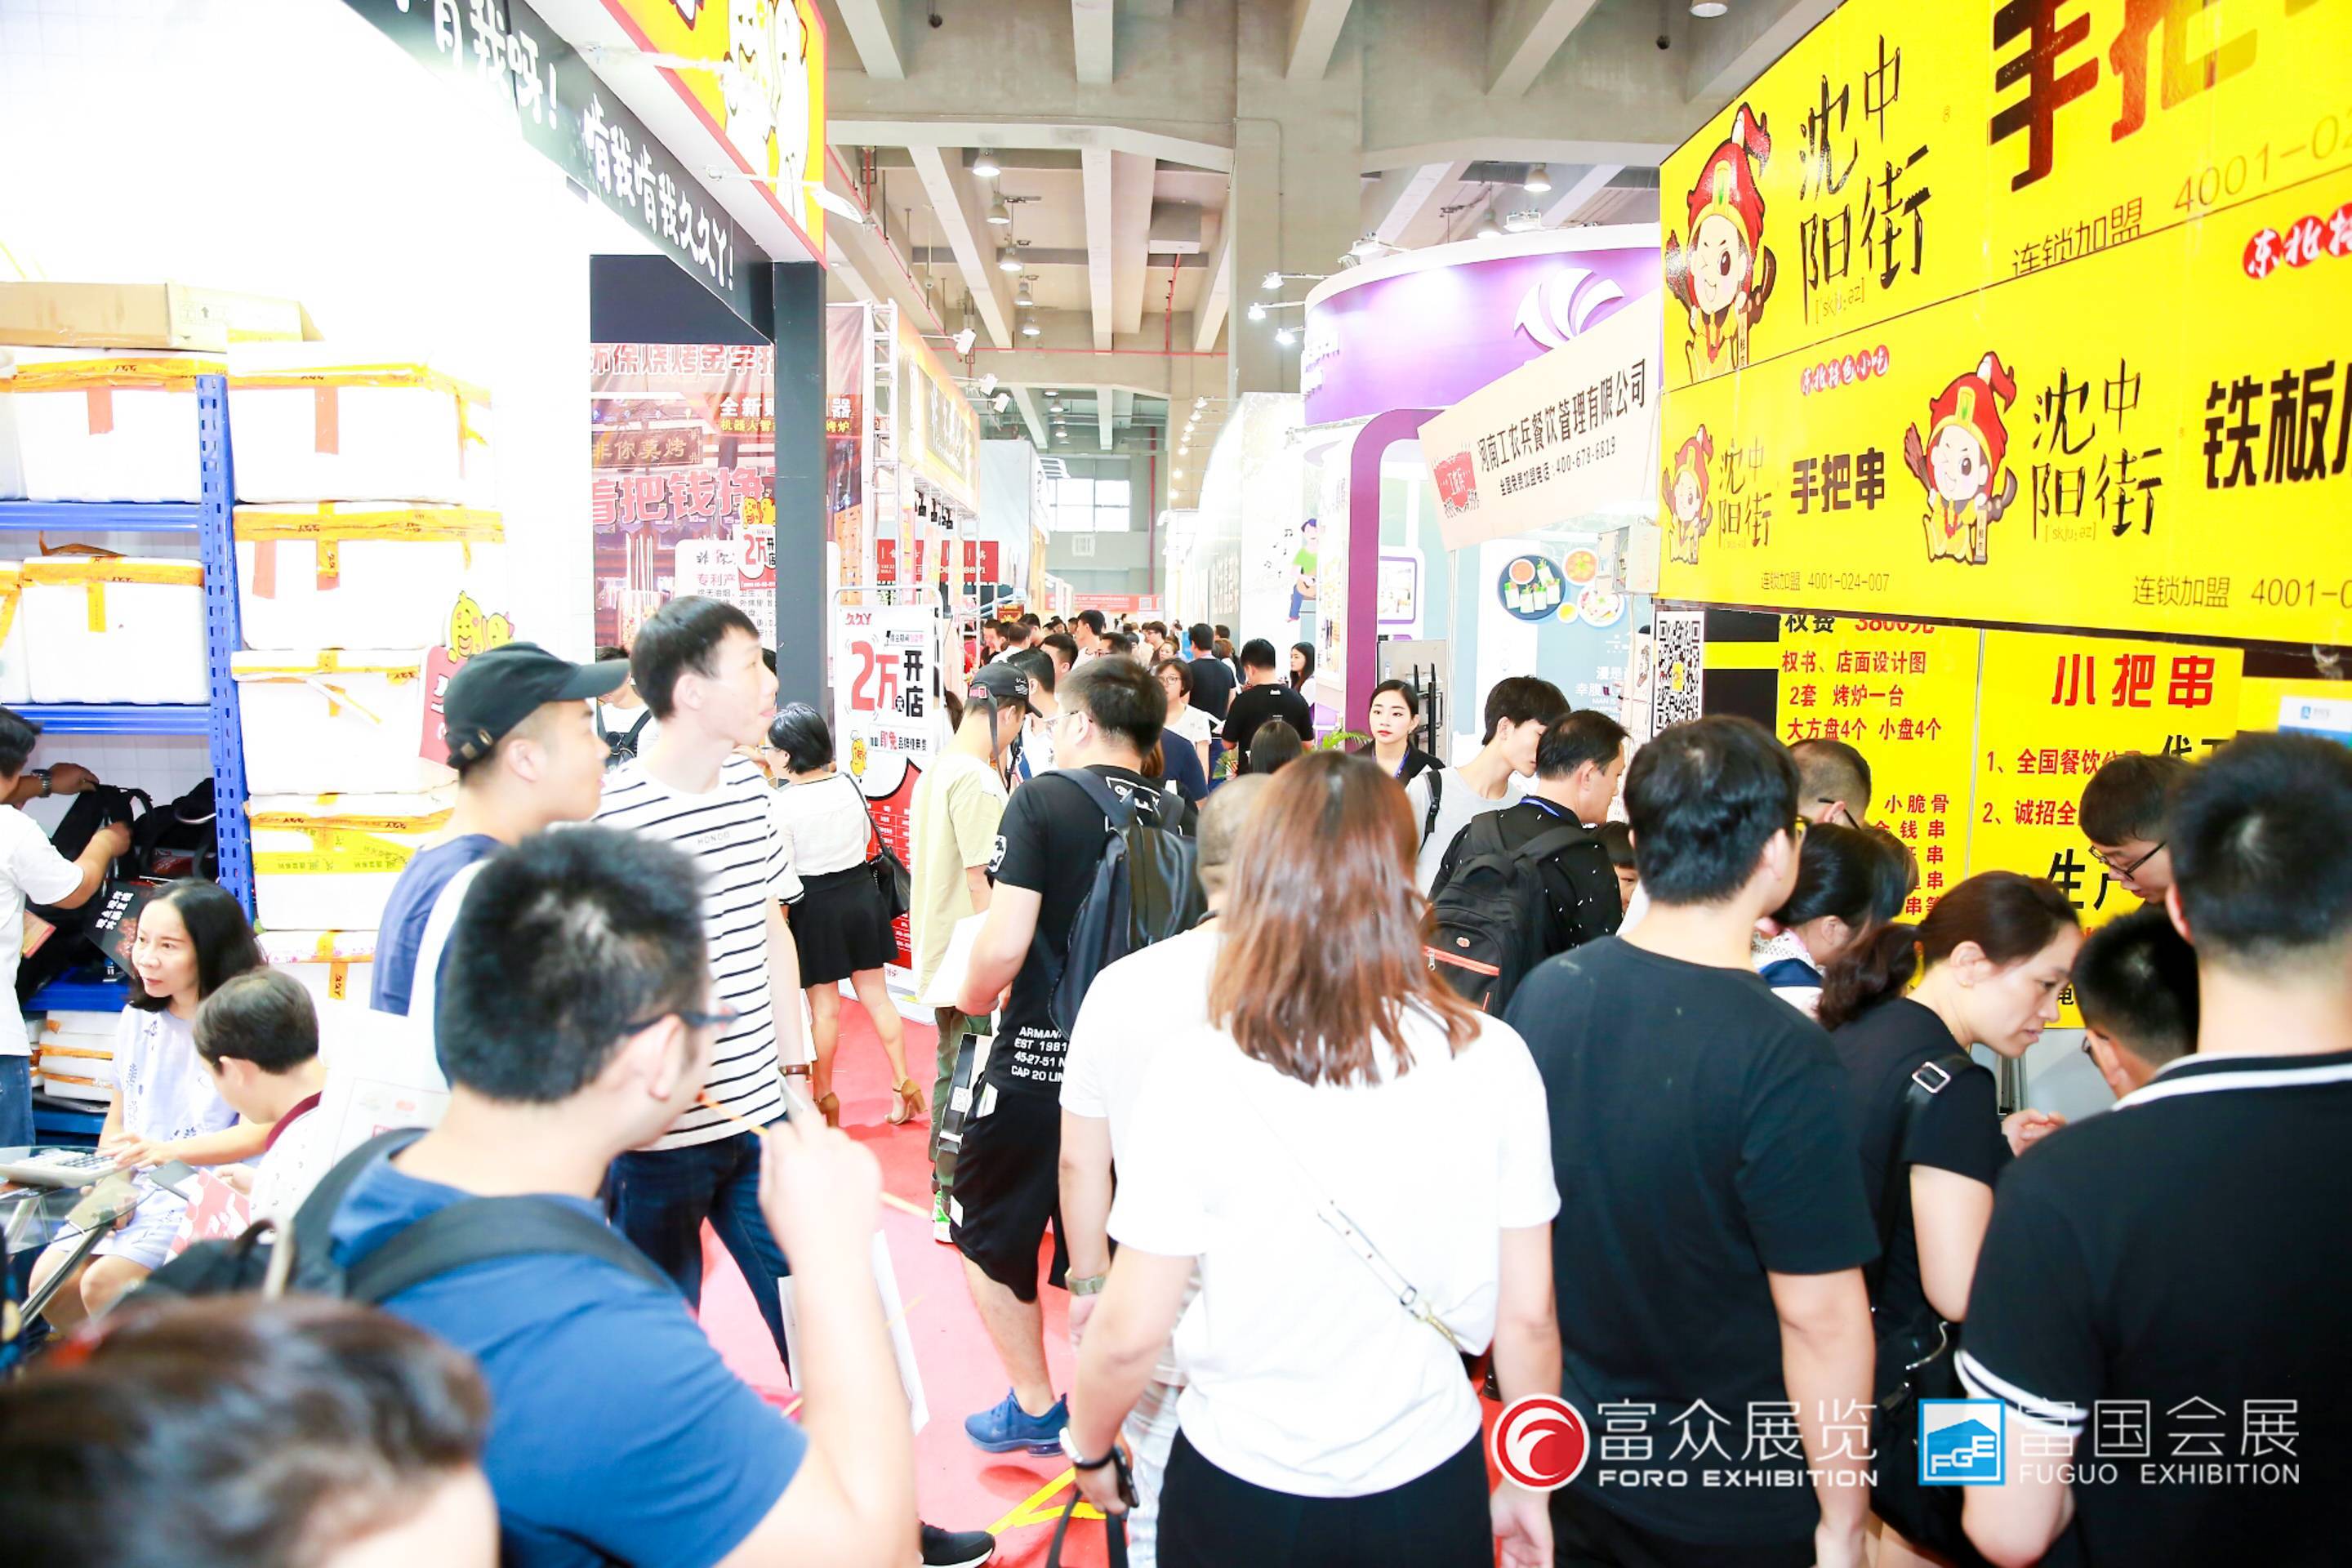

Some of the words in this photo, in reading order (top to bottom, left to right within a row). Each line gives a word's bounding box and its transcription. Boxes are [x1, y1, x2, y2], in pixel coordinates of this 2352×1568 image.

[2011, 196, 2143, 278] 连锁加盟
[1477, 358, 1646, 473] 河南工农兵餐饮管理有限公司
[2203, 359, 2352, 490] 铁板
[1791, 447, 1885, 514] 手把串
[1761, 571, 1801, 591] 连锁加盟
[1807, 572, 1890, 592] 4001-024-007
[2132, 575, 2230, 608] 连锁加盟
[2051, 653, 2216, 710] 小把串
[1789, 684, 1817, 708] 2套
[1832, 684, 1905, 708] 烤炉一台
[1787, 717, 1868, 741] 大方盘4个
[1879, 717, 1942, 742] 小盘4个
[1884, 794, 1949, 813] 小脆骨
[1014, 1037, 1035, 1049] EST
[1040, 1040, 1067, 1052] 1981
[1019, 1026, 1062, 1039] ARMAN
[1011, 1065, 1030, 1077] CAP
[1031, 1070, 1046, 1080] 20
